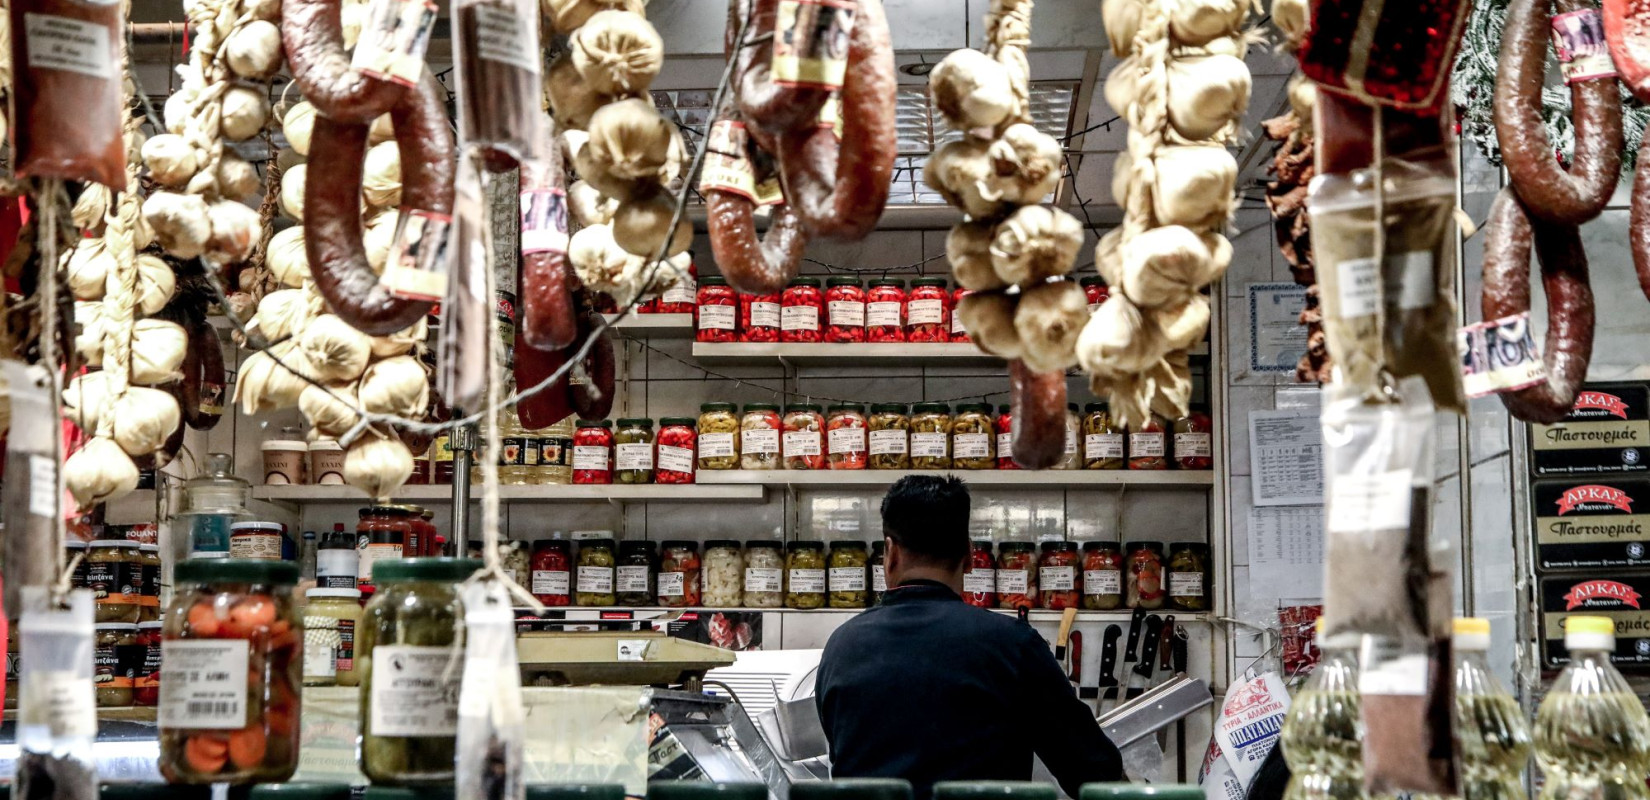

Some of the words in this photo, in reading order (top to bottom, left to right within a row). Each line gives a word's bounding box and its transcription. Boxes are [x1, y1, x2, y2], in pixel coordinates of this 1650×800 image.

[1575, 393, 1619, 409] ΡΚΑΣ
[1546, 426, 1637, 443] Παστουρμάς
[1566, 488, 1622, 504] ΑΡΚΑΣ
[1550, 520, 1642, 537] Παστουρμάς
[1575, 583, 1632, 599] ΑΡΚΑΣ
